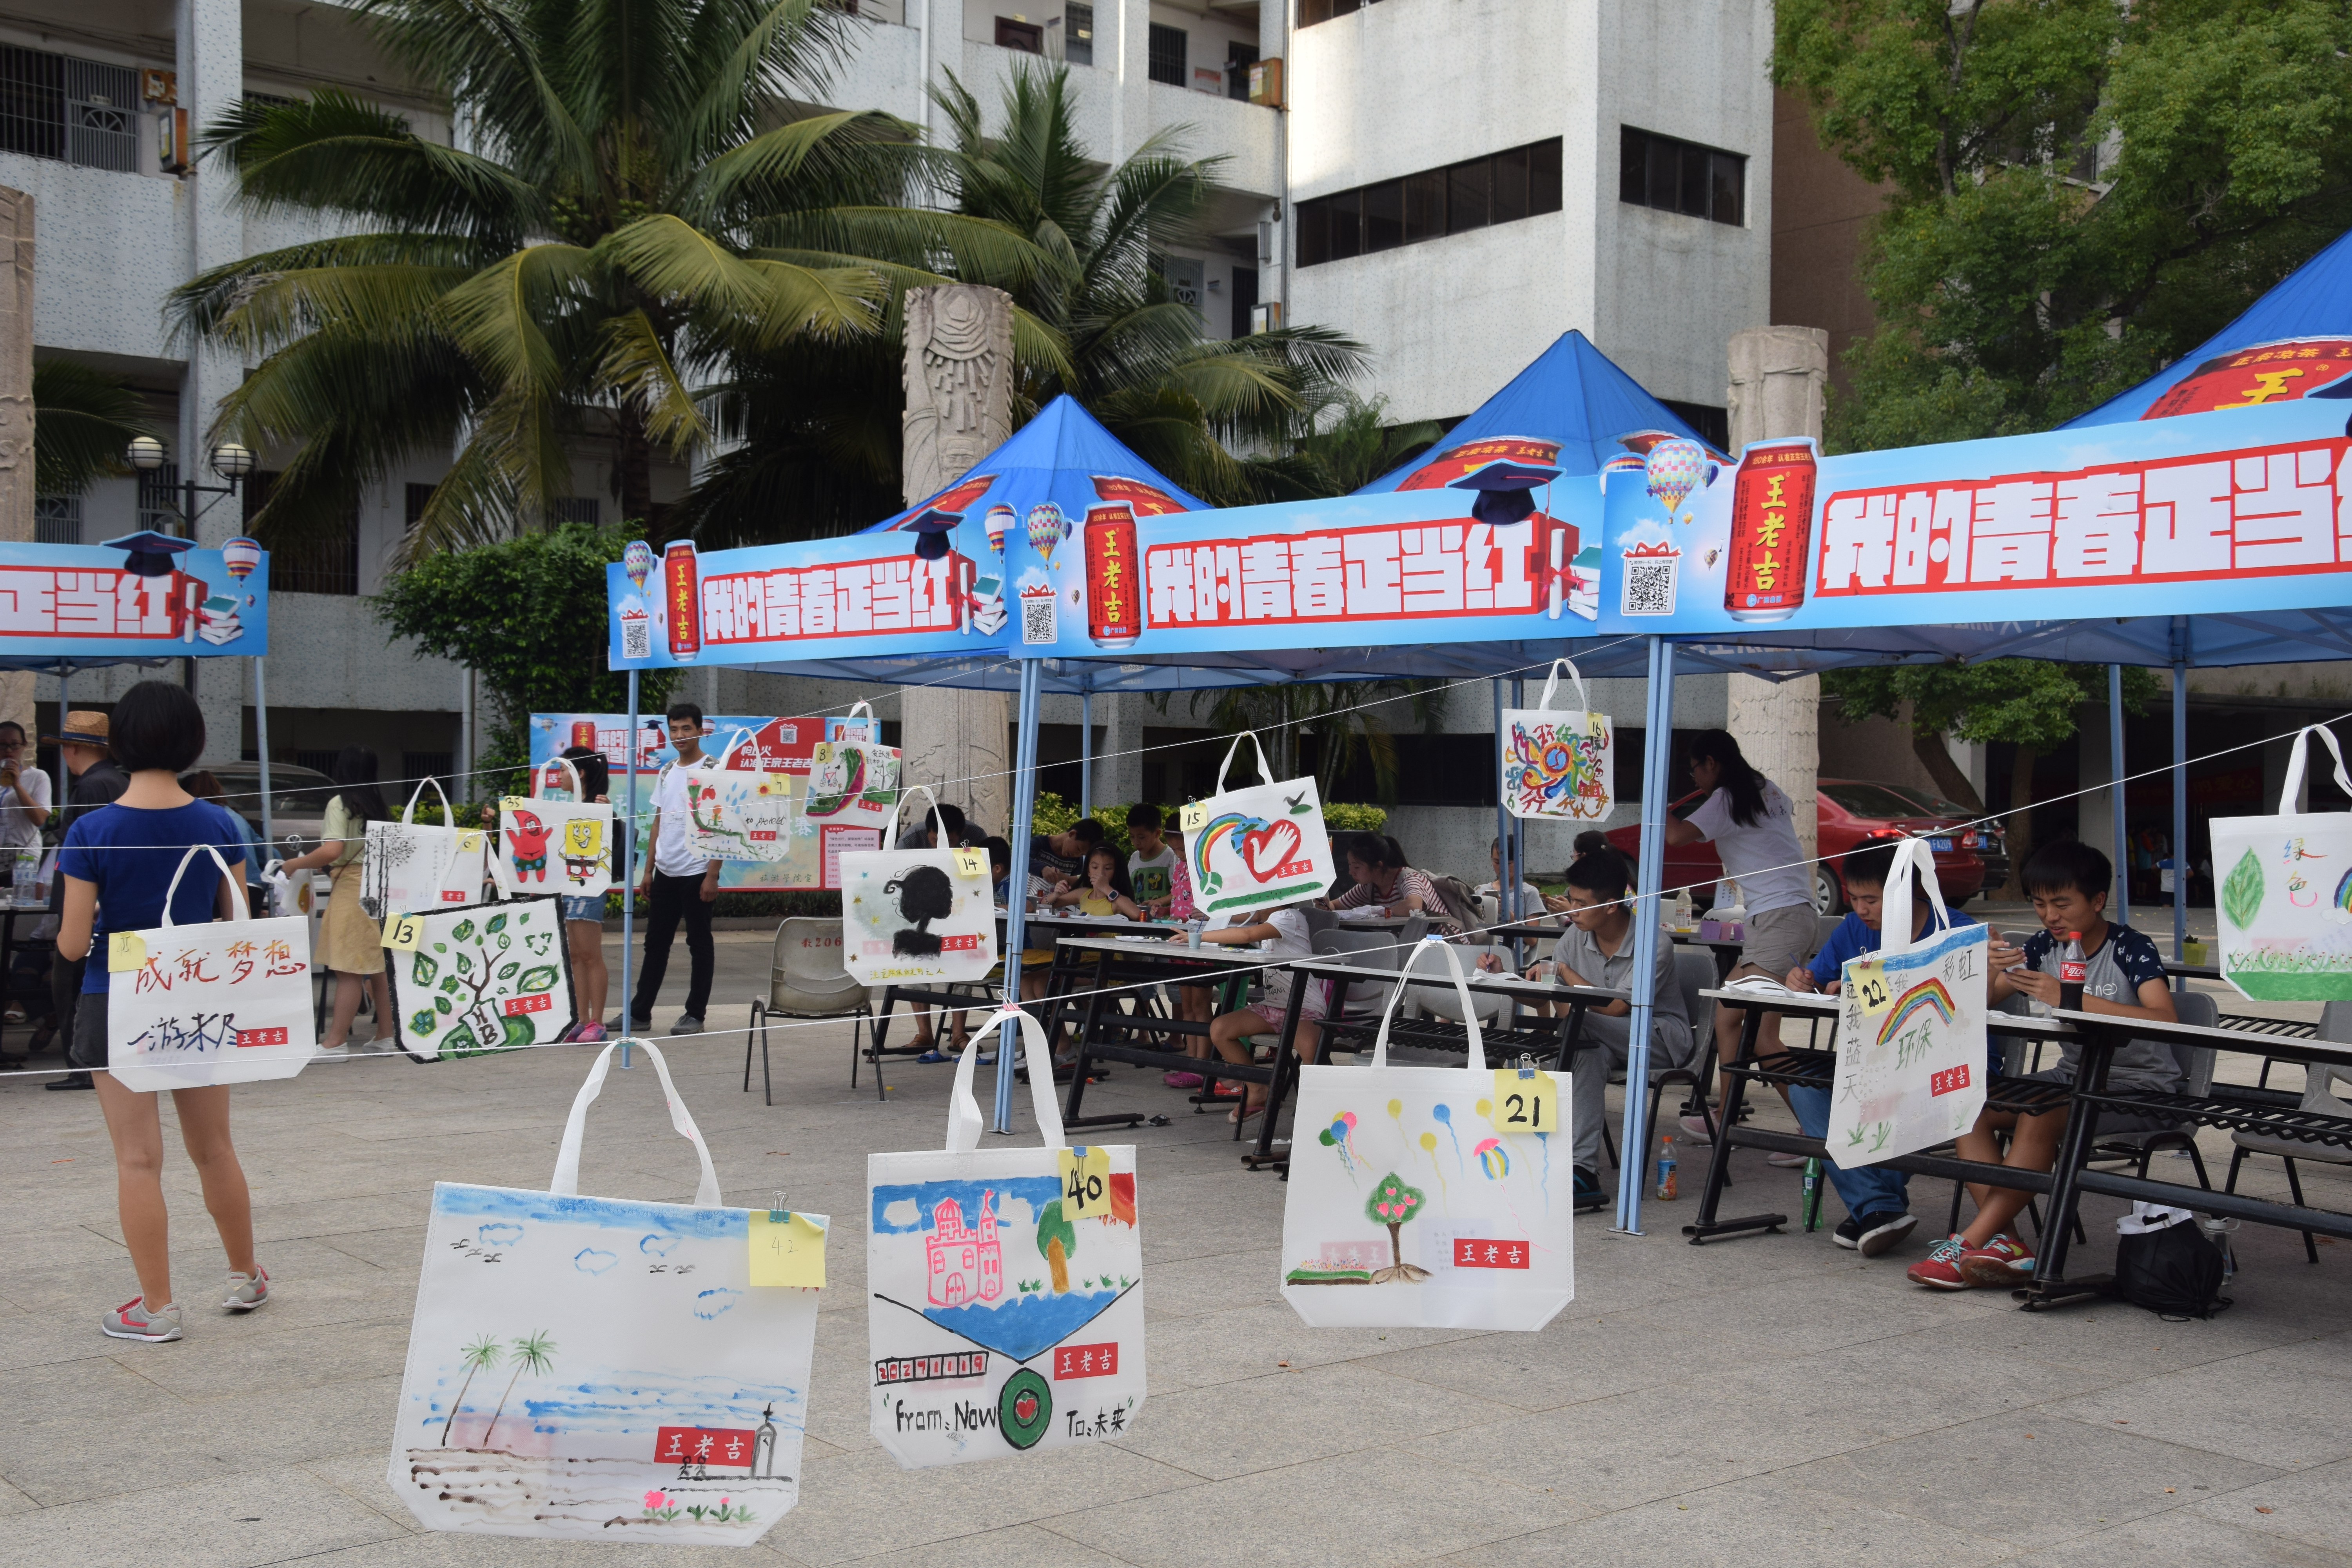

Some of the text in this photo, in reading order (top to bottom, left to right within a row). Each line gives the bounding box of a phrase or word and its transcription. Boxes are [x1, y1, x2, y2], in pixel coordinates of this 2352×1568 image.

[2230, 348, 2319, 367] 正宗凉茶
[1454, 446, 1507, 458] 正宗凉茶
[1516, 447, 1543, 457] 王老吉
[1753, 475, 1787, 590] 王老吉
[1103, 530, 1122, 623] 王老吉
[1149, 520, 1532, 622] 我的青春正当红
[676, 564, 689, 640] 王老吉
[704, 556, 952, 640] 我的青春正当红
[1592, 722, 1601, 736] 16
[819, 749, 826, 761] 8
[1581, 787, 1597, 795] 王吉
[506, 797, 521, 808] 35
[860, 801, 880, 810] 王老吉
[1187, 812, 1200, 826] 15
[963, 858, 977, 871] 14
[1280, 862, 1309, 876] 王老吉
[442, 892, 463, 900] 老吉
[392, 919, 413, 944] 13
[943, 938, 974, 949] 王老吉
[136, 940, 307, 995] 成就梦想
[1942, 949, 1978, 982] 彩虹
[511, 997, 547, 1013] 王老吉
[242, 1031, 283, 1044] 王老吉
[1895, 1018, 1933, 1071] 环保
[1935, 1069, 1966, 1092] 王老吉
[1505, 1094, 1540, 1127] 21
[1068, 1168, 1102, 1210] 40
[771, 1236, 799, 1256] 42
[1461, 1244, 1522, 1264] 王老吉
[1060, 1349, 1112, 1374] 王老吉
[664, 1434, 745, 1460] 王老吉
